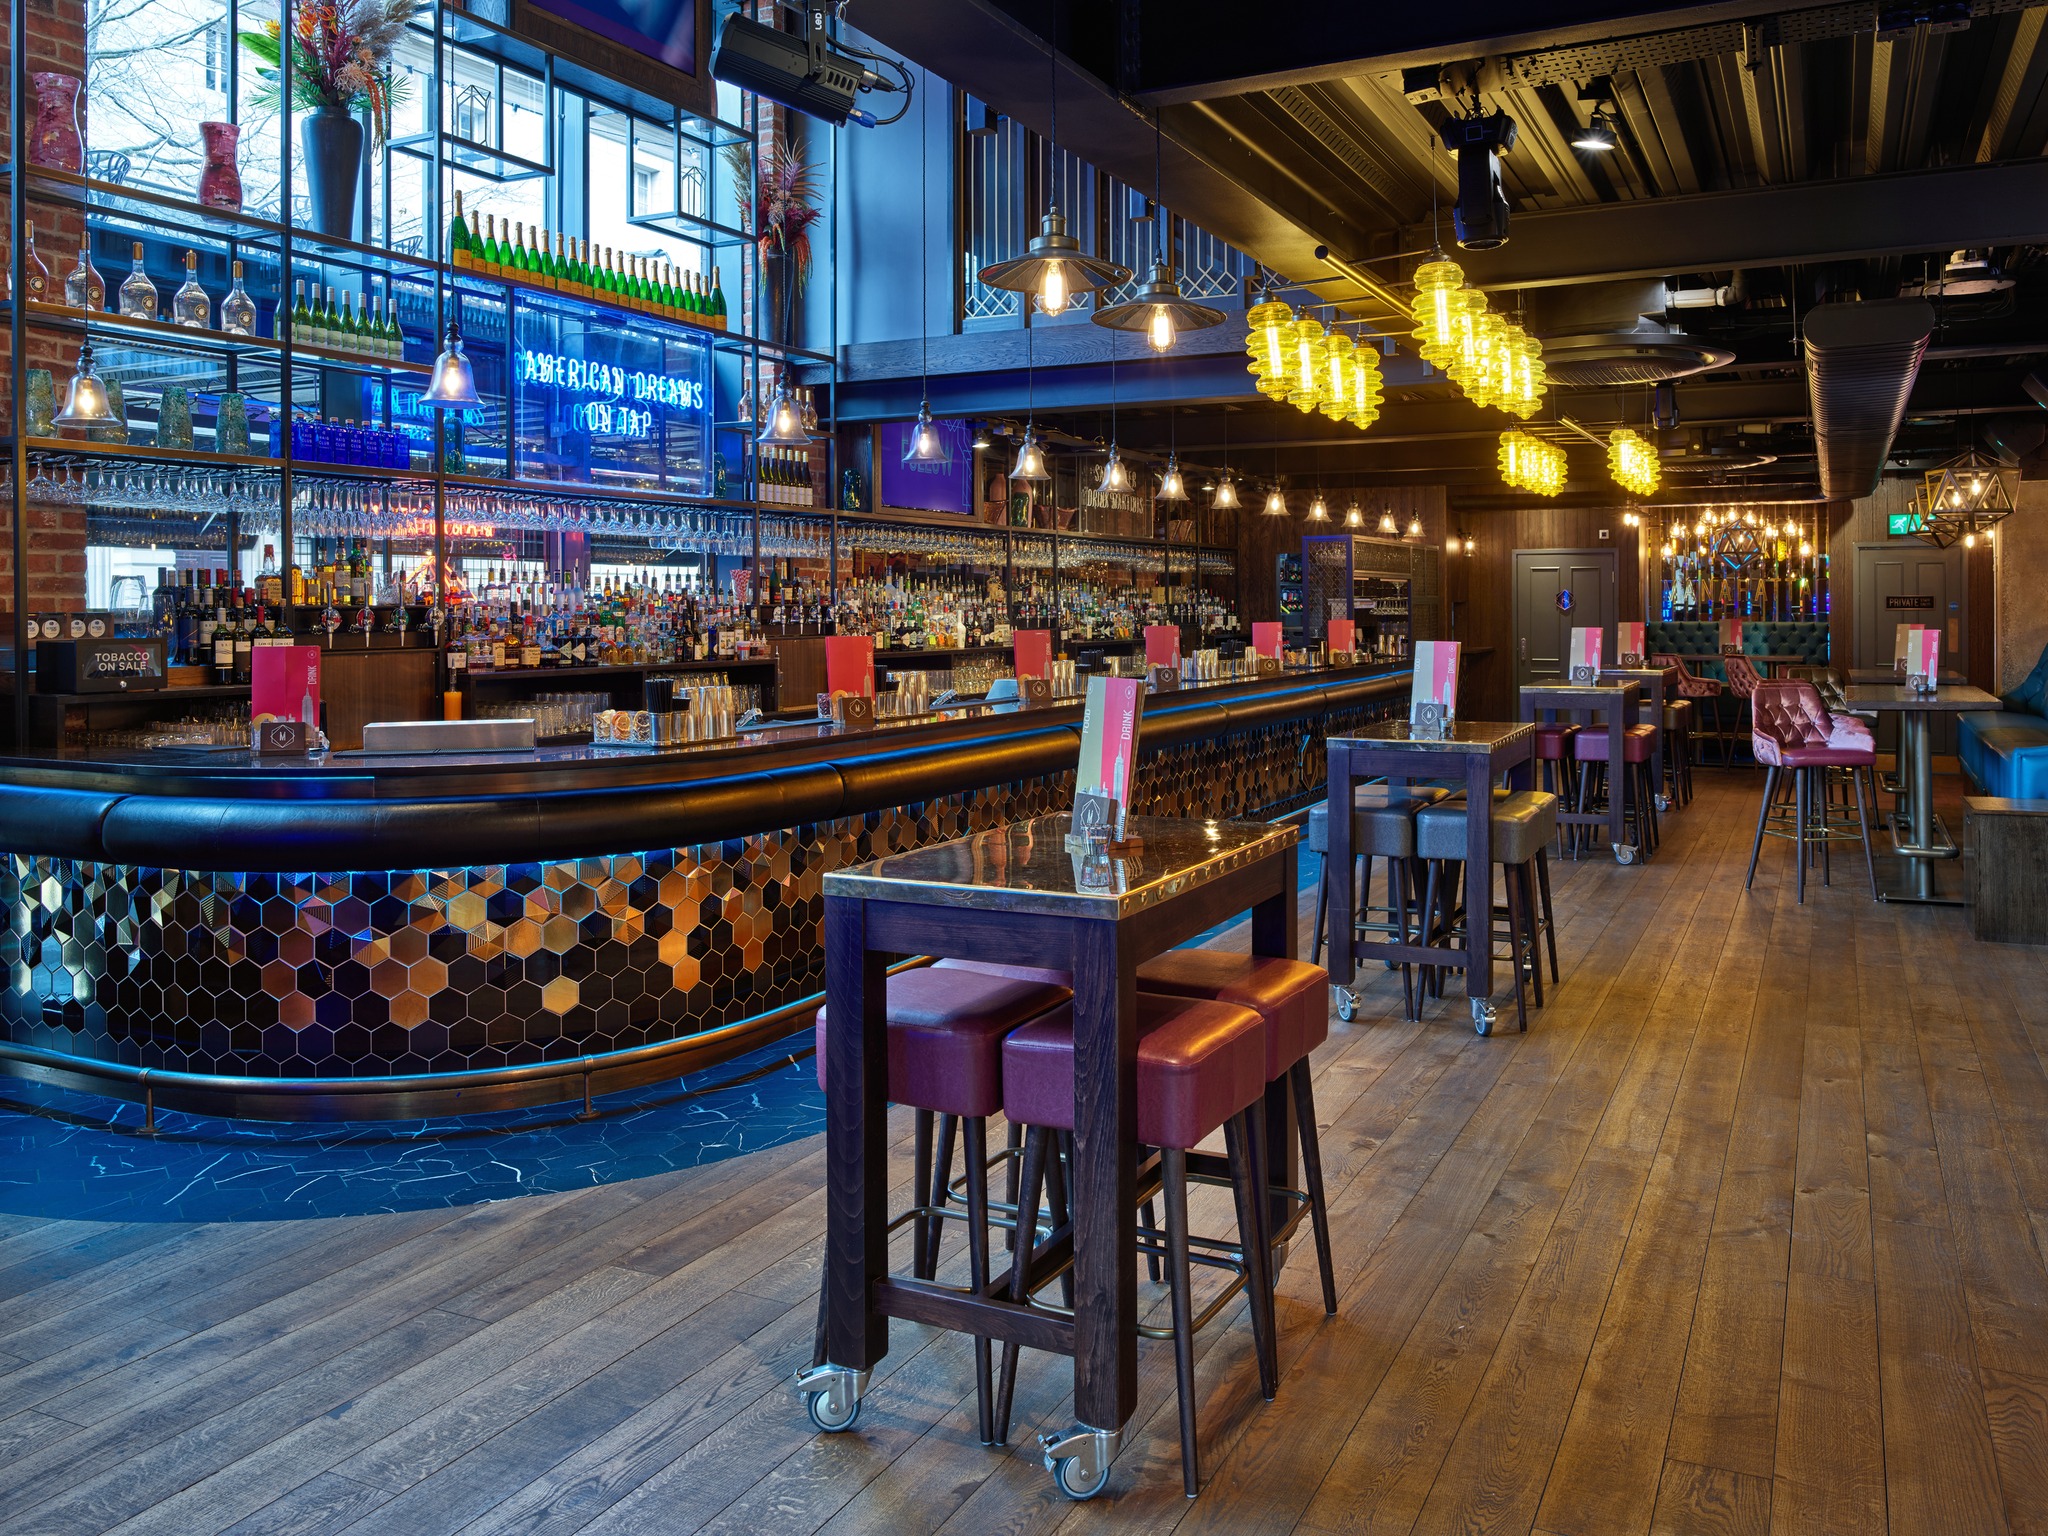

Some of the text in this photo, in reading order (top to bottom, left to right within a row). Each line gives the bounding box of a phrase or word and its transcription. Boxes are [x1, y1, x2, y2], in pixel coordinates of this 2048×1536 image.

[524, 350, 703, 409] AMERICAN DREAMS
[588, 402, 652, 437] ON TAP
[1087, 488, 1144, 514] DRINK MARTINIS
[1889, 598, 1919, 607] PRIVATE
[95, 652, 150, 662] TOBACCO
[98, 662, 146, 672] ON SALE
[308, 666, 316, 684] DRINK
[1082, 708, 1091, 734] FOOD
[1121, 710, 1133, 740] DRINK
[280, 732, 286, 741] M
